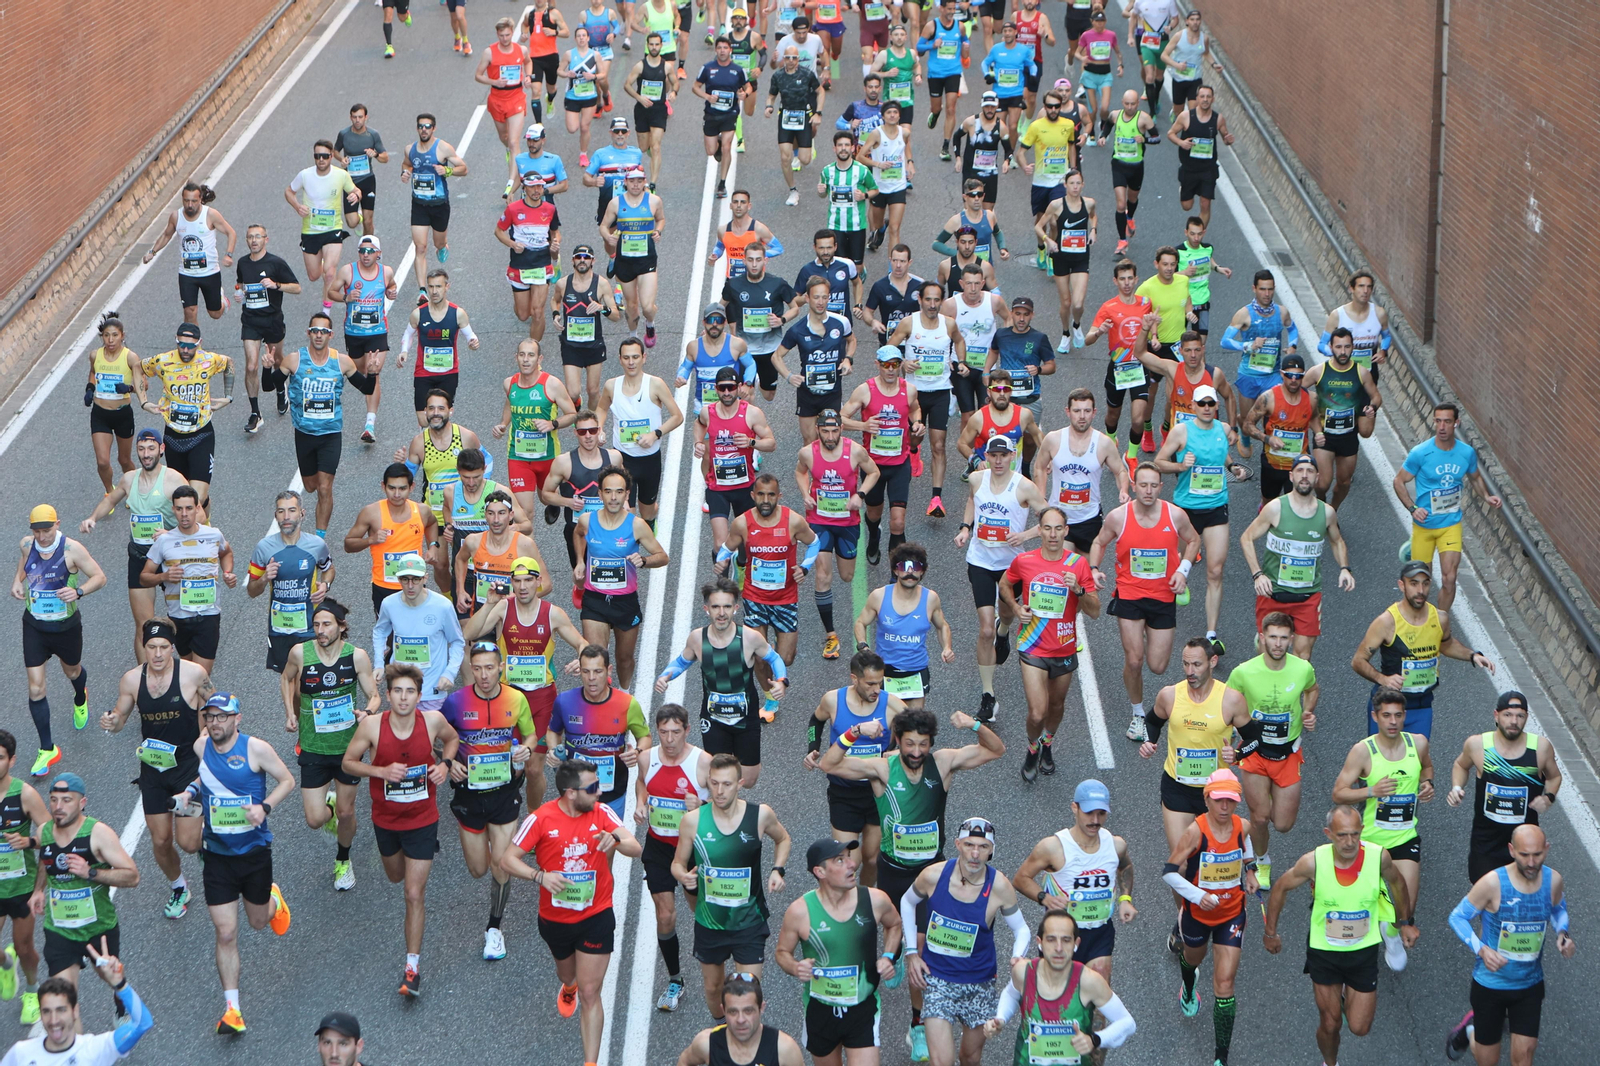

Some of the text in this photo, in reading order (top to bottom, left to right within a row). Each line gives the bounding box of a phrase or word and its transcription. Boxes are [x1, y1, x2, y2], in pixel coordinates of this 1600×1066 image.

[1059, 463, 1090, 476] PHOENIX
[1435, 464, 1460, 474] CEU
[979, 502, 1009, 515] PHOENIX
[1270, 538, 1290, 553] PALAS
[1057, 622, 1074, 630] RUN
[884, 633, 920, 643] BEASAIN
[326, 698, 347, 706] ZURICH
[142, 710, 181, 720] SWORDS
[150, 742, 170, 750] ZURICH
[1217, 854, 1238, 862] ZURICH
[946, 922, 971, 932] ZURICH
[943, 933, 957, 941] 1750
